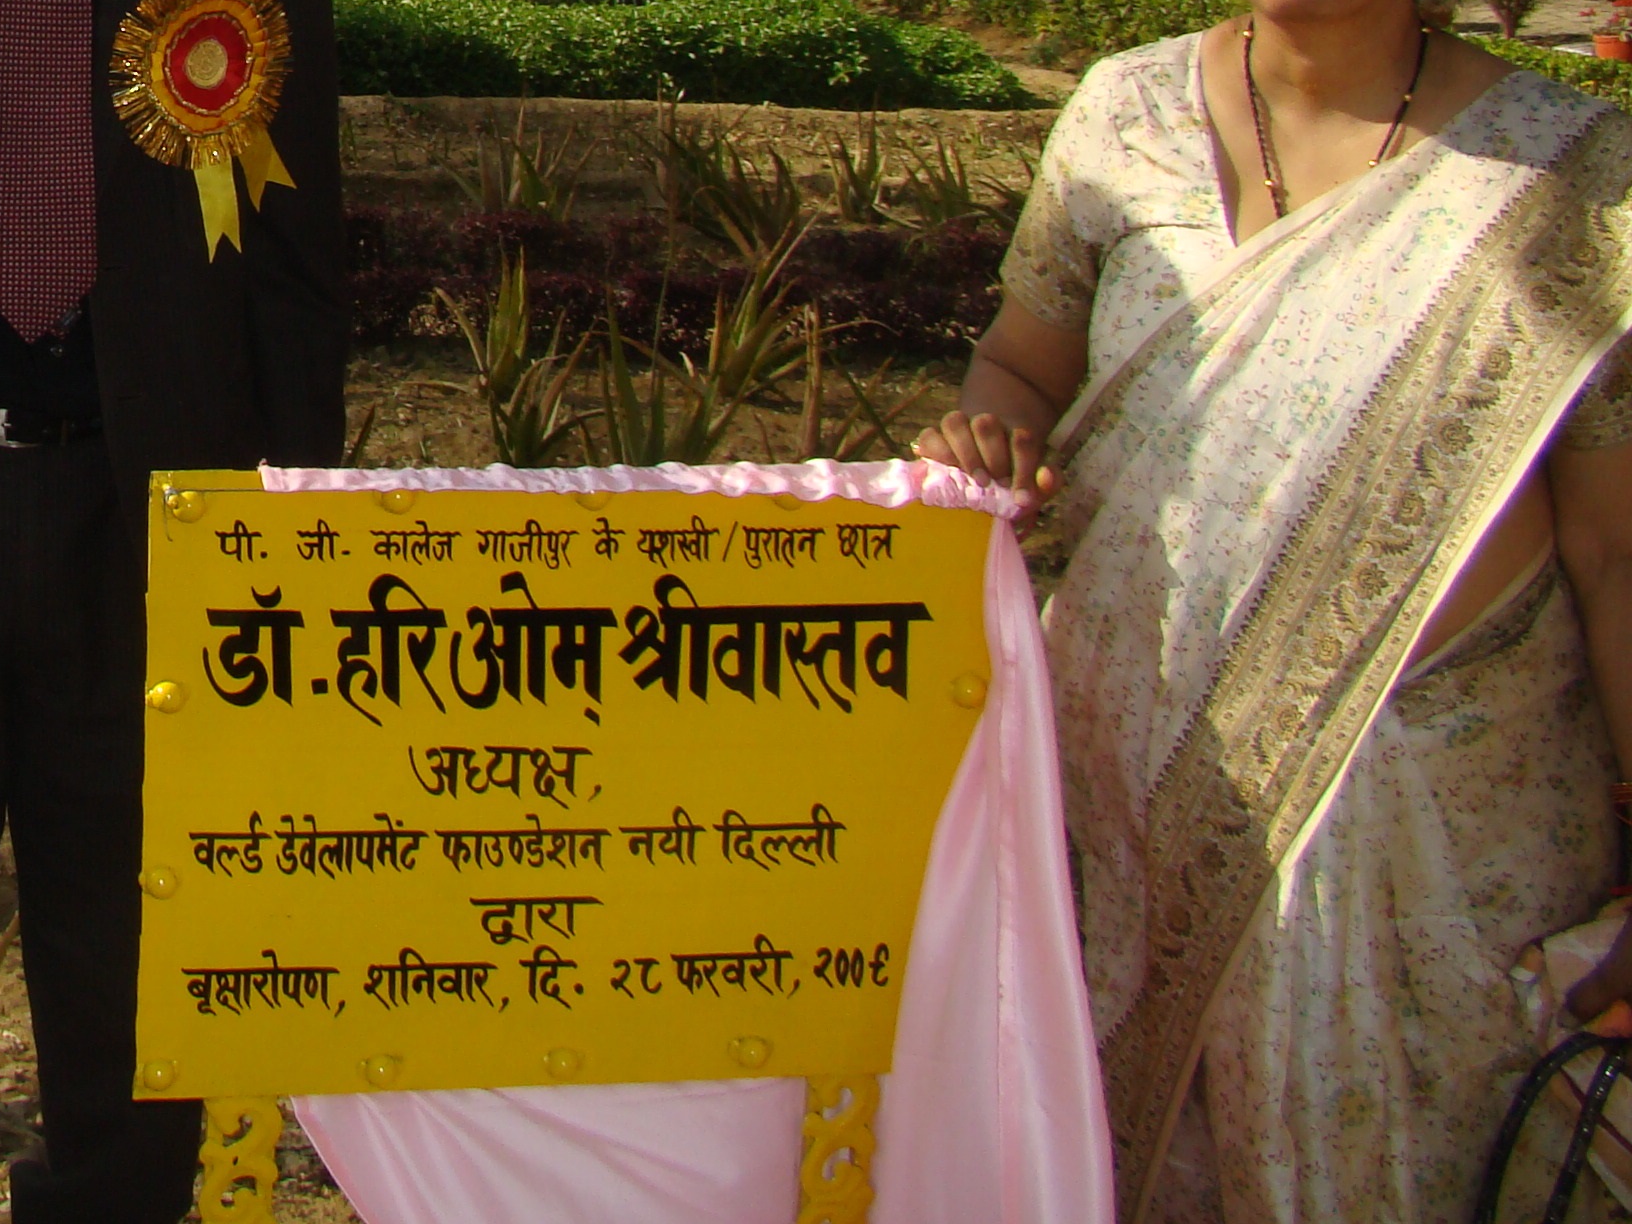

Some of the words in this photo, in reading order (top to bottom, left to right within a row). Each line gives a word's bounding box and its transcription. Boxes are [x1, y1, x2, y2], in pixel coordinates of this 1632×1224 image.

[216, 520, 268, 563] पी.
[371, 520, 462, 564] कालेज
[476, 519, 580, 574] गाजीपुर
[593, 517, 625, 561] के
[836, 524, 901, 566] छात्र
[620, 574, 934, 714] श्रीवास्तव
[189, 814, 273, 877] वर्ल्ड
[434, 814, 612, 873] फाउण्डेशन
[619, 806, 707, 866] नयी
[713, 803, 847, 872] दिल्ली
[469, 897, 604, 946] द्वारा
[363, 948, 510, 1011] शनिवार,
[519, 940, 585, 1010] दि.
[610, 958, 663, 999] २८
[671, 934, 801, 998] फरवरी,
